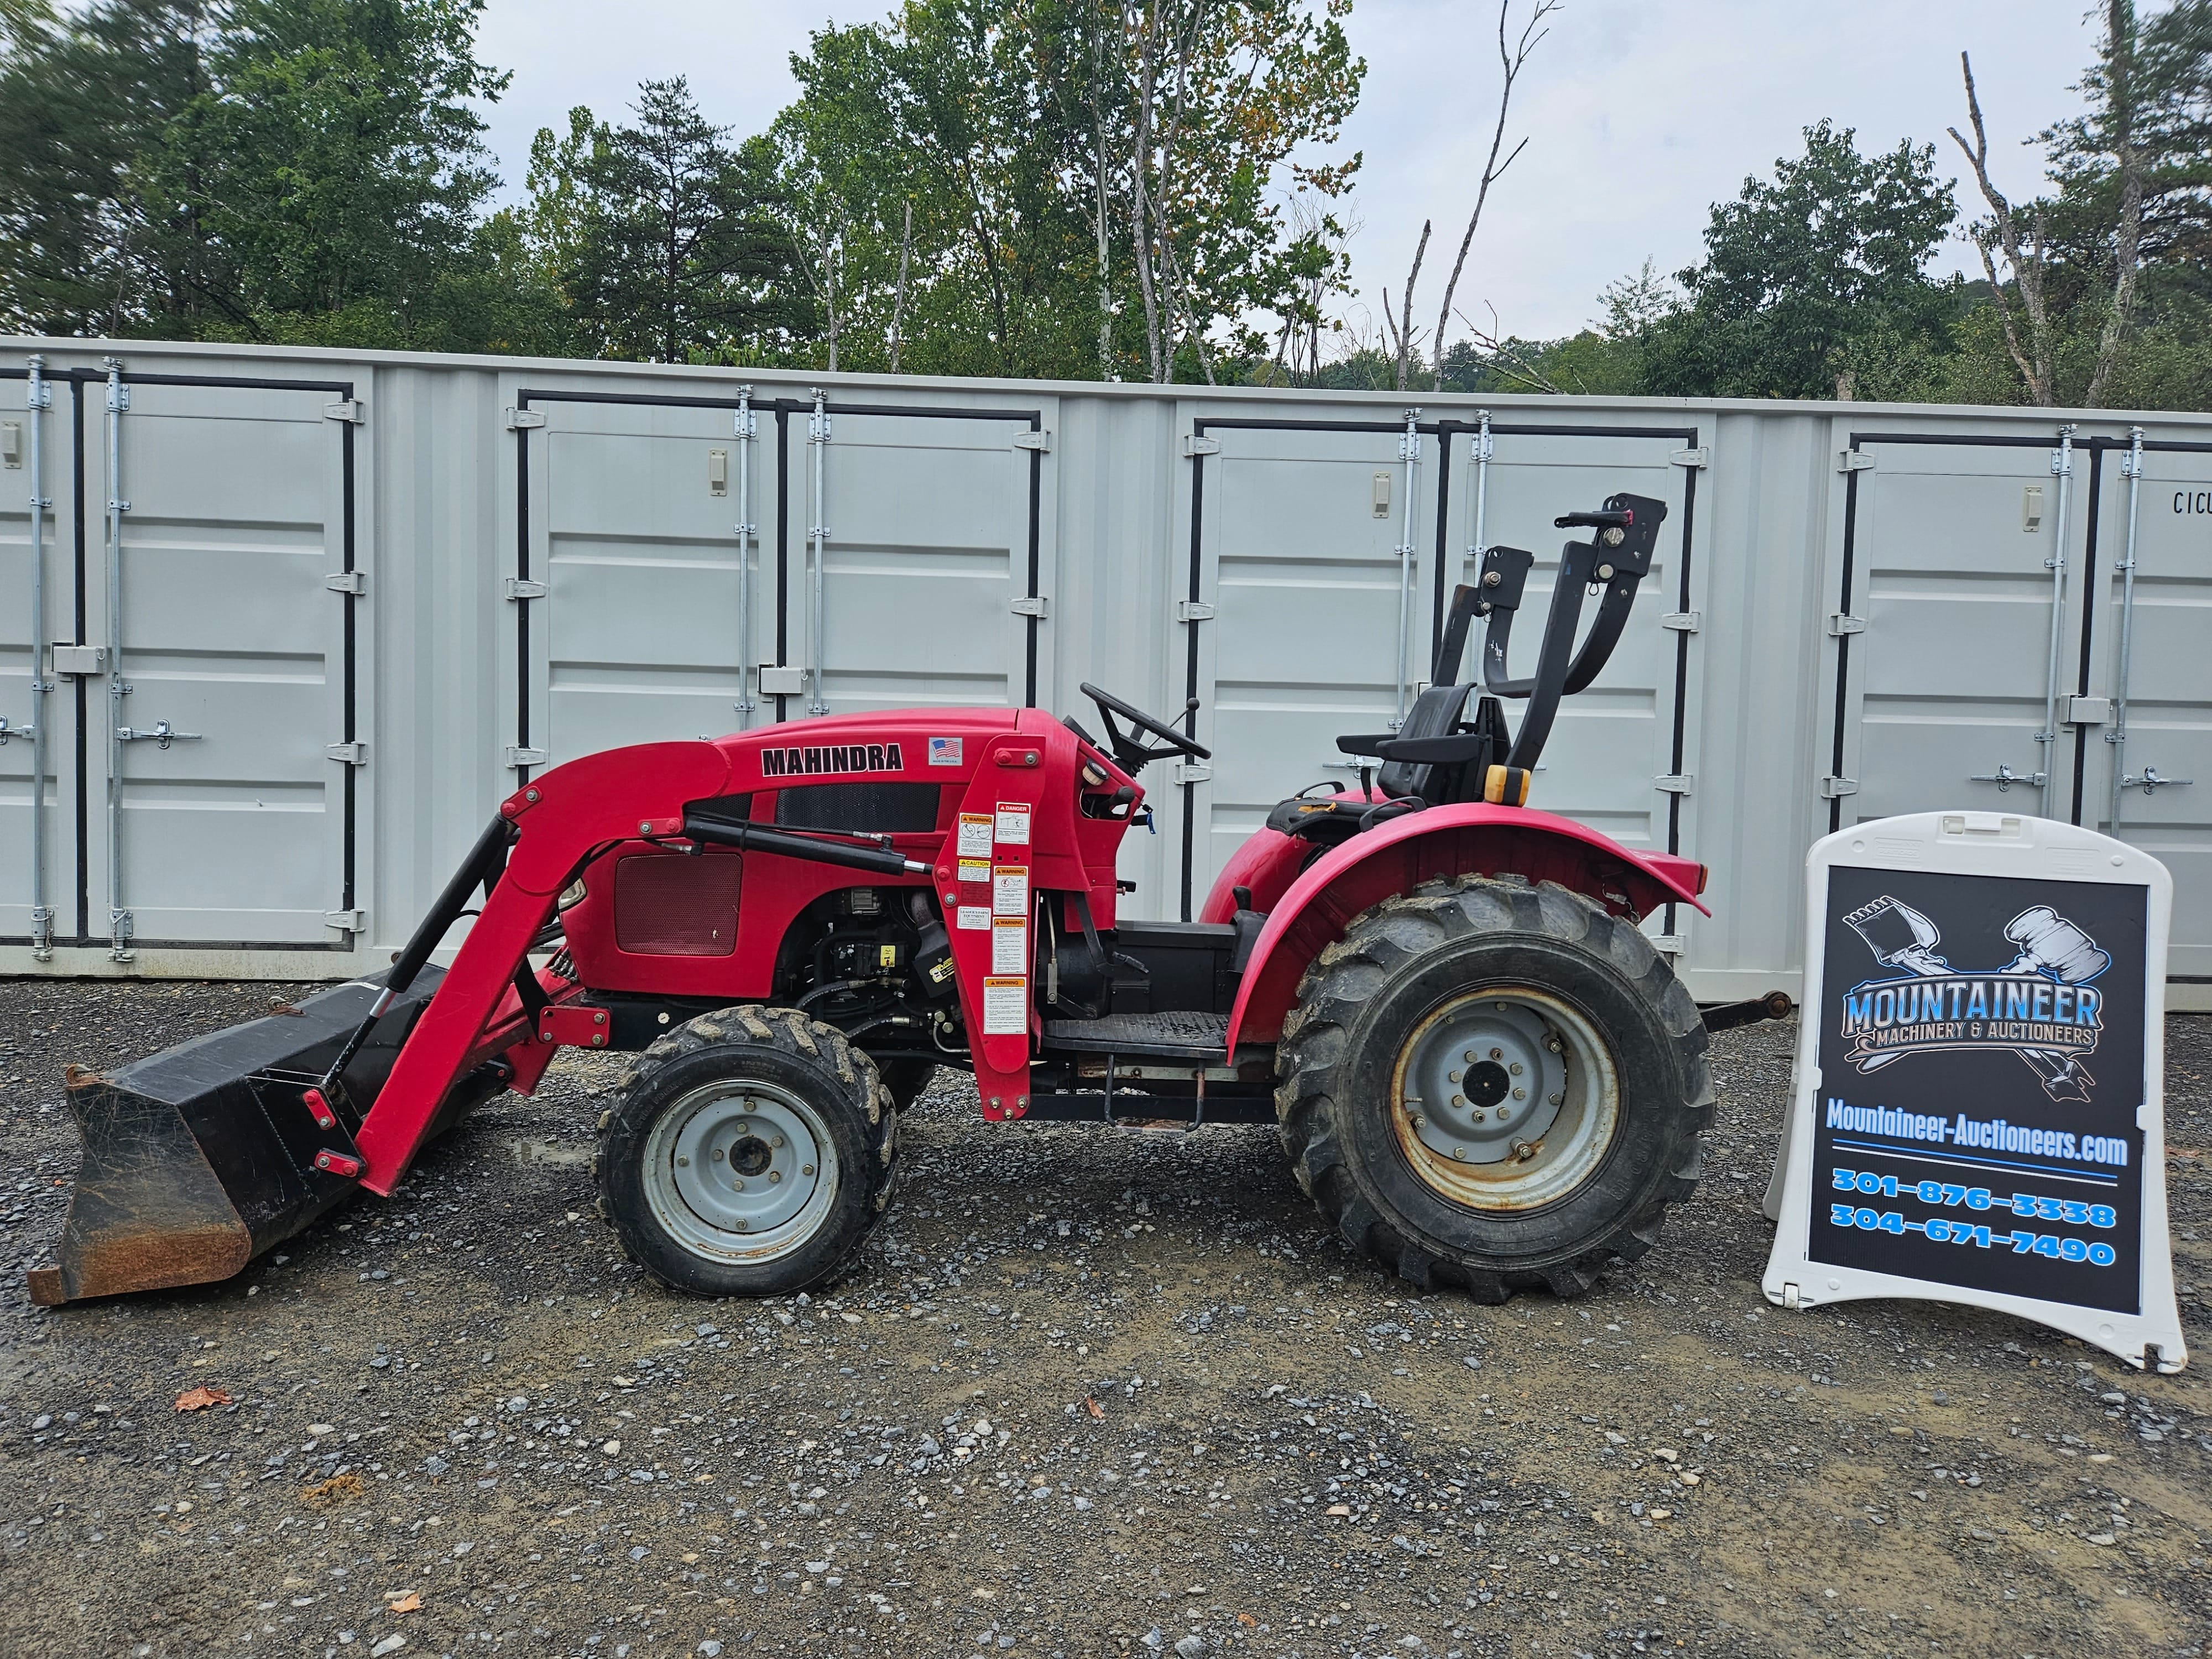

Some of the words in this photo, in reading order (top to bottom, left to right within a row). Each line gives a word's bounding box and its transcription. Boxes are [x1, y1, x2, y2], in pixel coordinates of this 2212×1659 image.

[762, 744, 903, 776] MAHINDRA
[1846, 981, 2103, 1034] MOUNTAINEER
[1876, 1022, 1964, 1047] MACHINERY
[1970, 1021, 1983, 1037] &
[1987, 1022, 2094, 1045] AUCTIONEERS
[1826, 1098, 2127, 1166] Mountaineer-Auctioneers.com
[1832, 1167, 2116, 1228] 301-876-3338
[1830, 1204, 2116, 1266] 304-671-7490
